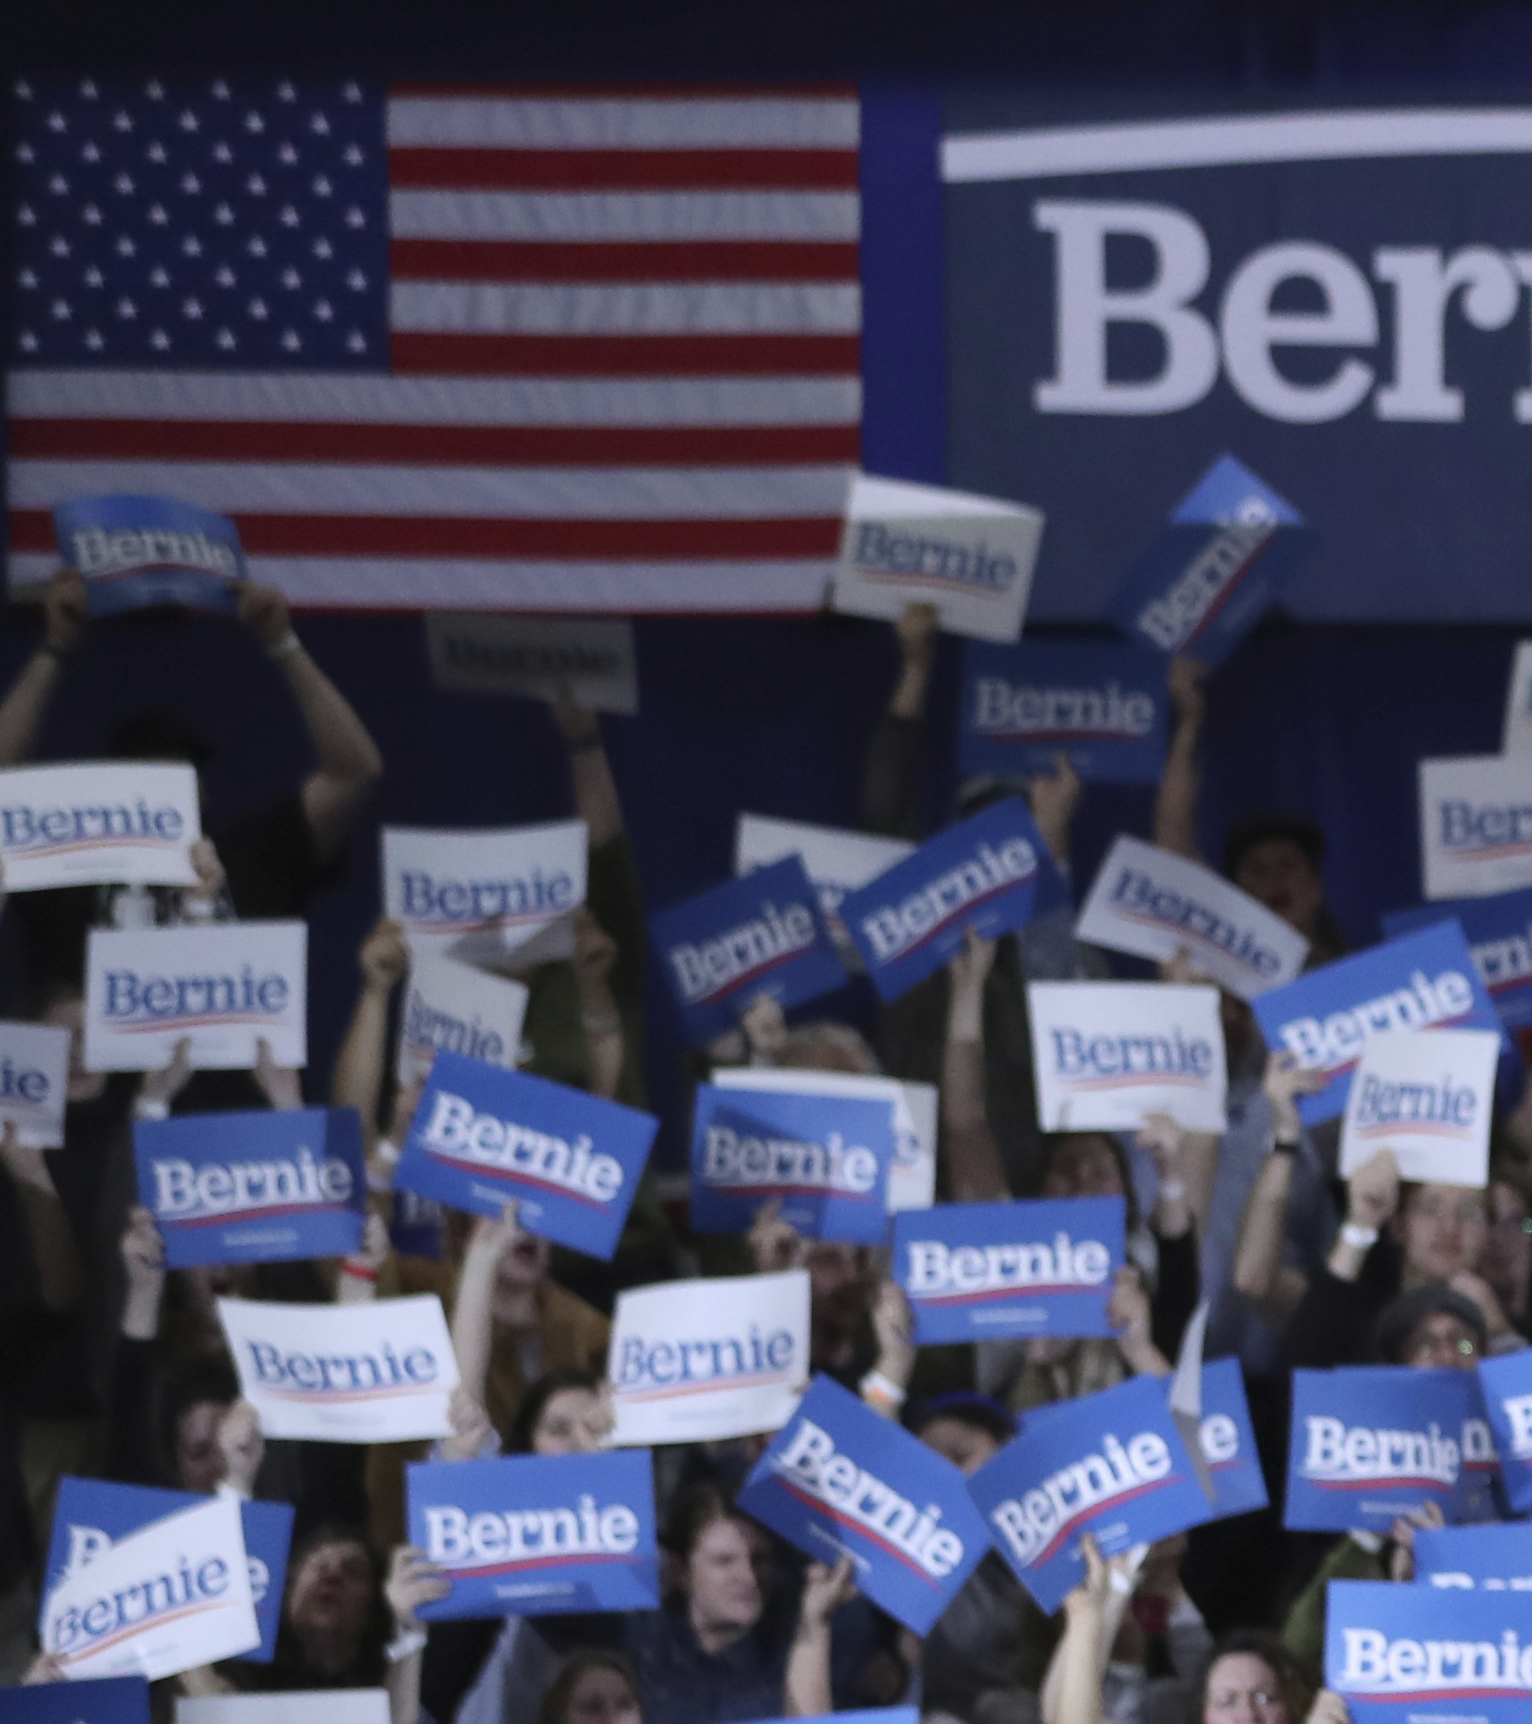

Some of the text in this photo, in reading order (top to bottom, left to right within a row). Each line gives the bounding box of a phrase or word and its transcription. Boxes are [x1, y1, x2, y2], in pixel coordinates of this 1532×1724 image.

[852, 522, 1018, 581] Bernie
[974, 678, 1155, 736] Bernie
[3, 798, 184, 845] Bernie
[400, 871, 573, 917] Bernie
[862, 836, 1038, 964] Bernie
[673, 893, 816, 1005] Bernie
[1116, 865, 1282, 986] Bernie
[104, 969, 288, 1015] Bernie
[1280, 966, 1475, 1069] Bernie
[1054, 1021, 1211, 1079] Bernie
[1359, 1074, 1477, 1129] Bernie
[153, 1146, 352, 1206] Bernie
[426, 1091, 624, 1204] Bernie
[703, 1132, 878, 1190] Bernie
[905, 1233, 1109, 1289] Bernie
[249, 1336, 438, 1386] Bernie
[618, 1316, 793, 1385] Bernie
[1307, 1413, 1459, 1474] Bernie
[779, 1414, 965, 1579] Bernie
[991, 1430, 1172, 1556] Bernie
[425, 1494, 639, 1562] Bernie
[53, 1553, 232, 1649] Bernie
